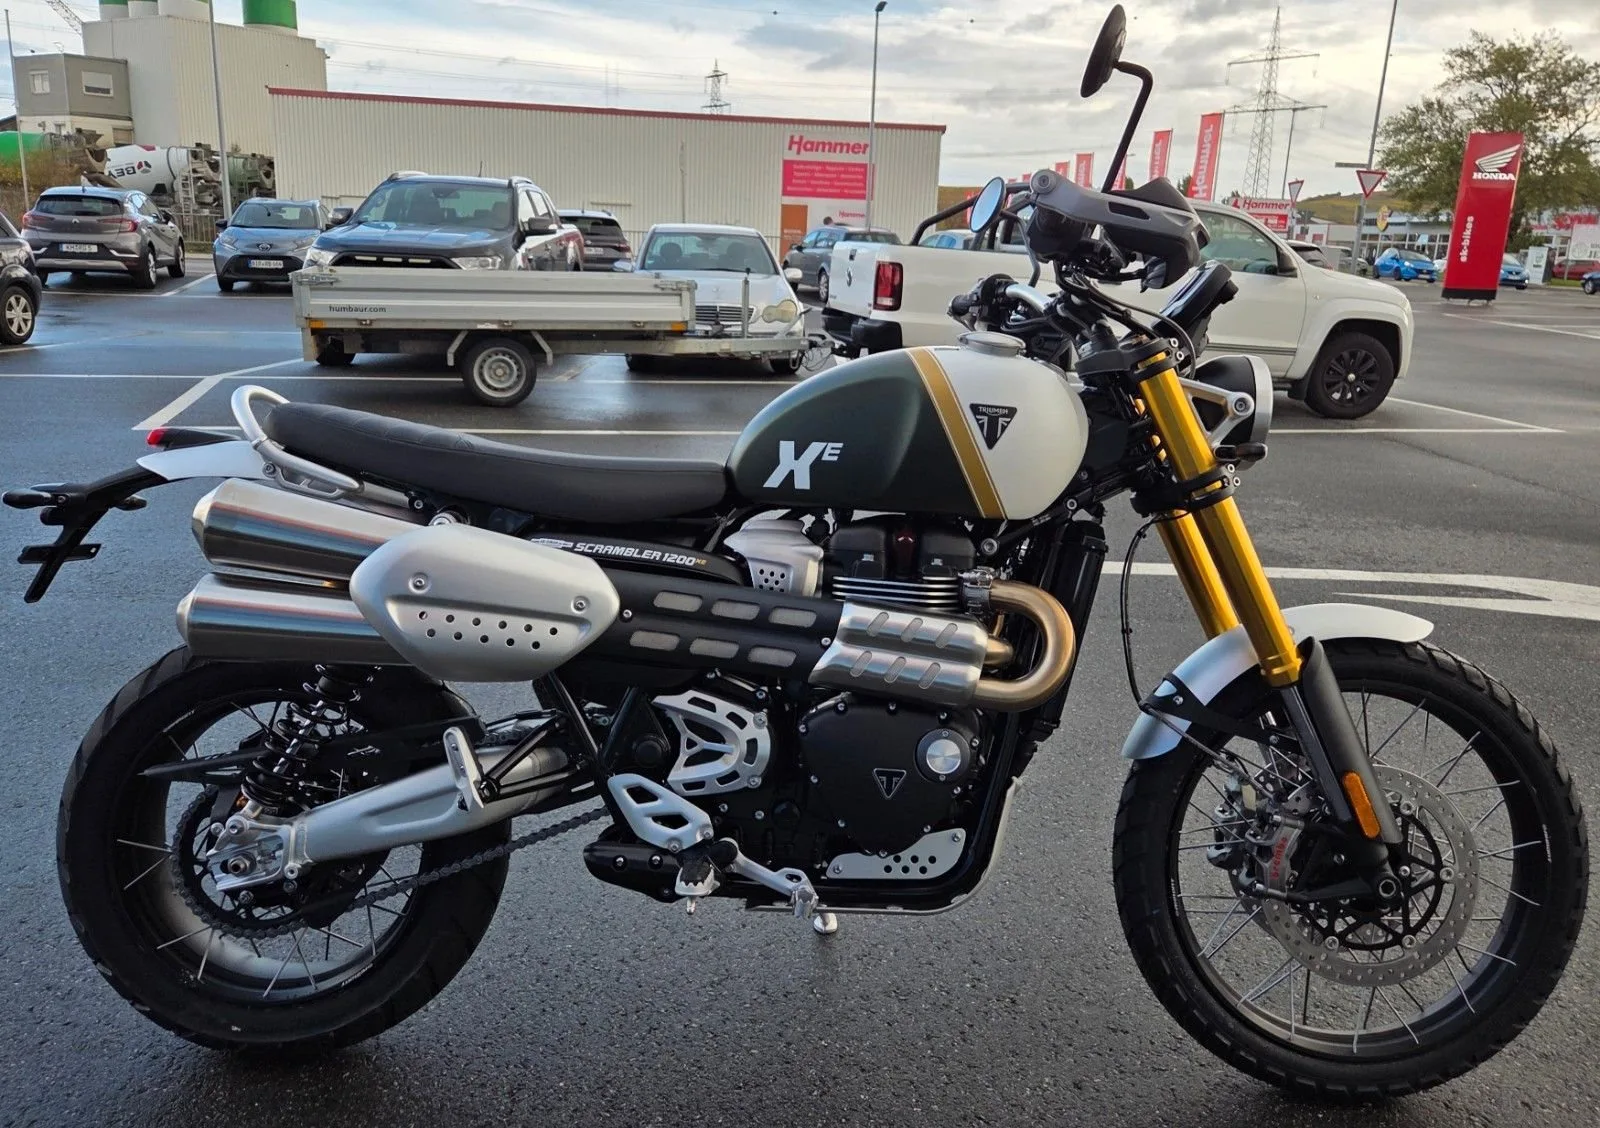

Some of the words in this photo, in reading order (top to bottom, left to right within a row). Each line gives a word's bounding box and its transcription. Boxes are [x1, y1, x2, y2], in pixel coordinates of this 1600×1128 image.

[787, 135, 869, 155] Hammer
[1472, 171, 1516, 181] HONDA
[1242, 197, 1290, 210] Hammer
[1460, 215, 1475, 263] ek-bikes
[328, 305, 387, 314] humbaur.com
[978, 406, 1009, 416] TRIUMPH
[574, 542, 660, 561] SCRAMBLER
[662, 553, 697, 566] 1200
